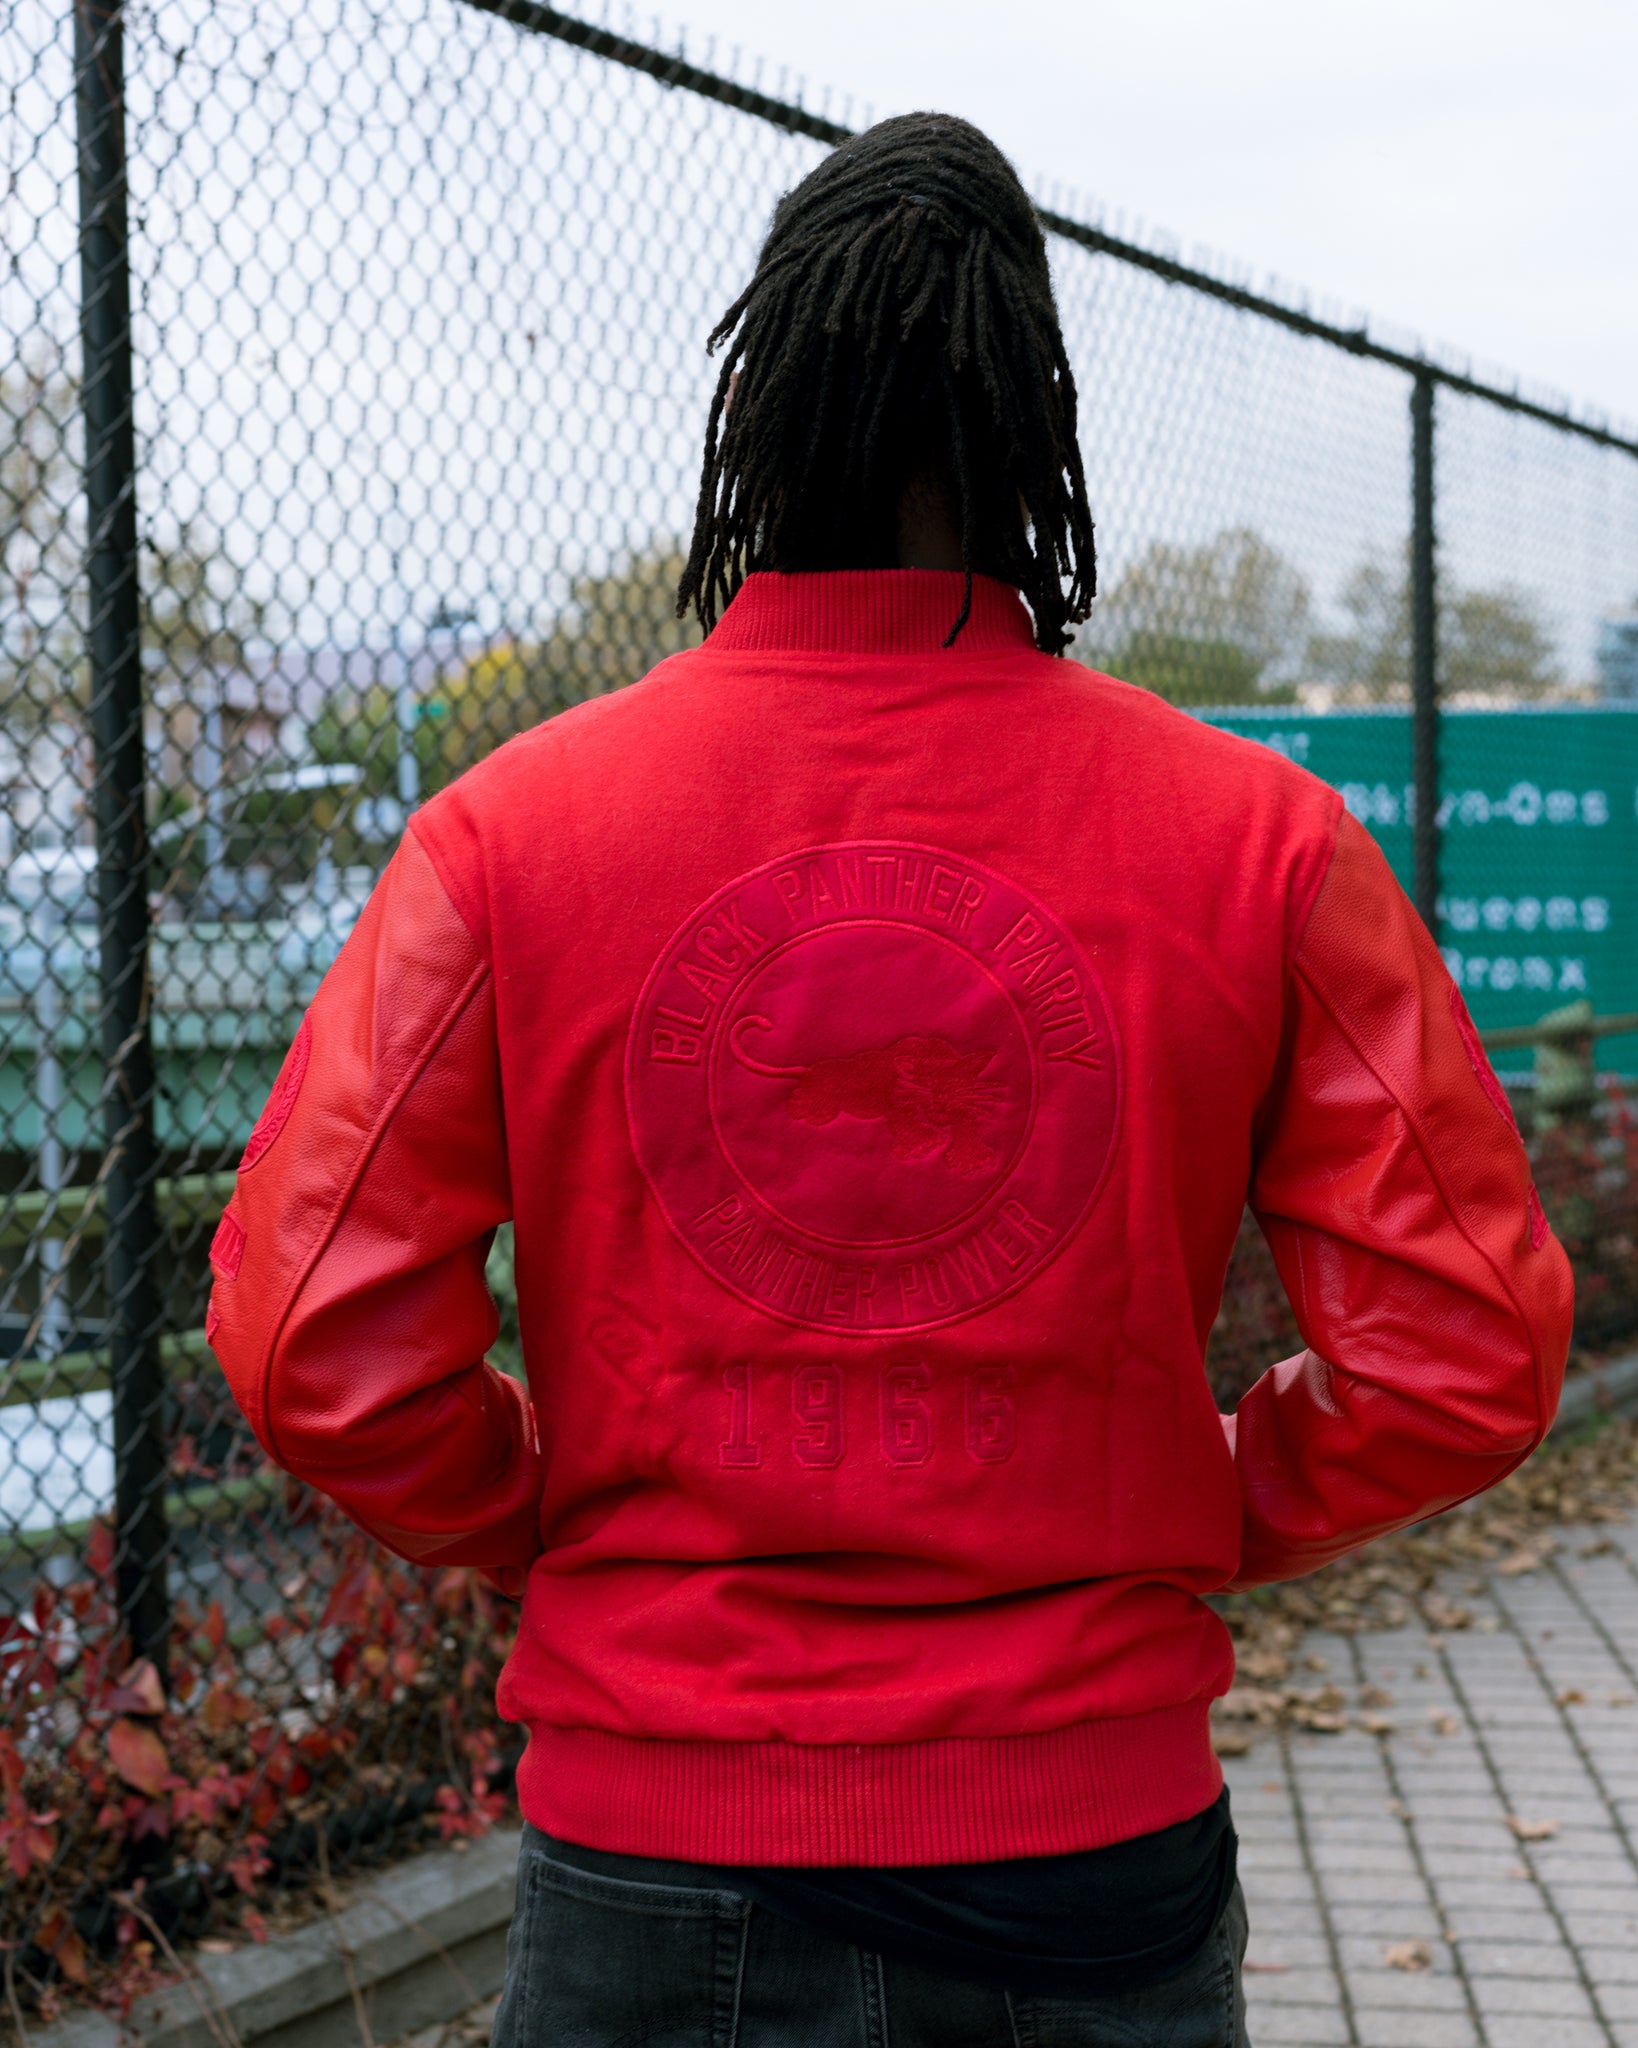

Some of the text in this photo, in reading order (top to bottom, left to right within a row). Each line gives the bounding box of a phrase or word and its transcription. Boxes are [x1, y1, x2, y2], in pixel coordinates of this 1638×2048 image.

[650, 855, 1101, 1072] BLACK PANTHER PARTY
[1436, 896, 1609, 932] ueens
[692, 1195, 1054, 1323] PANTHER POWER
[719, 1362, 1018, 1467] 1966
